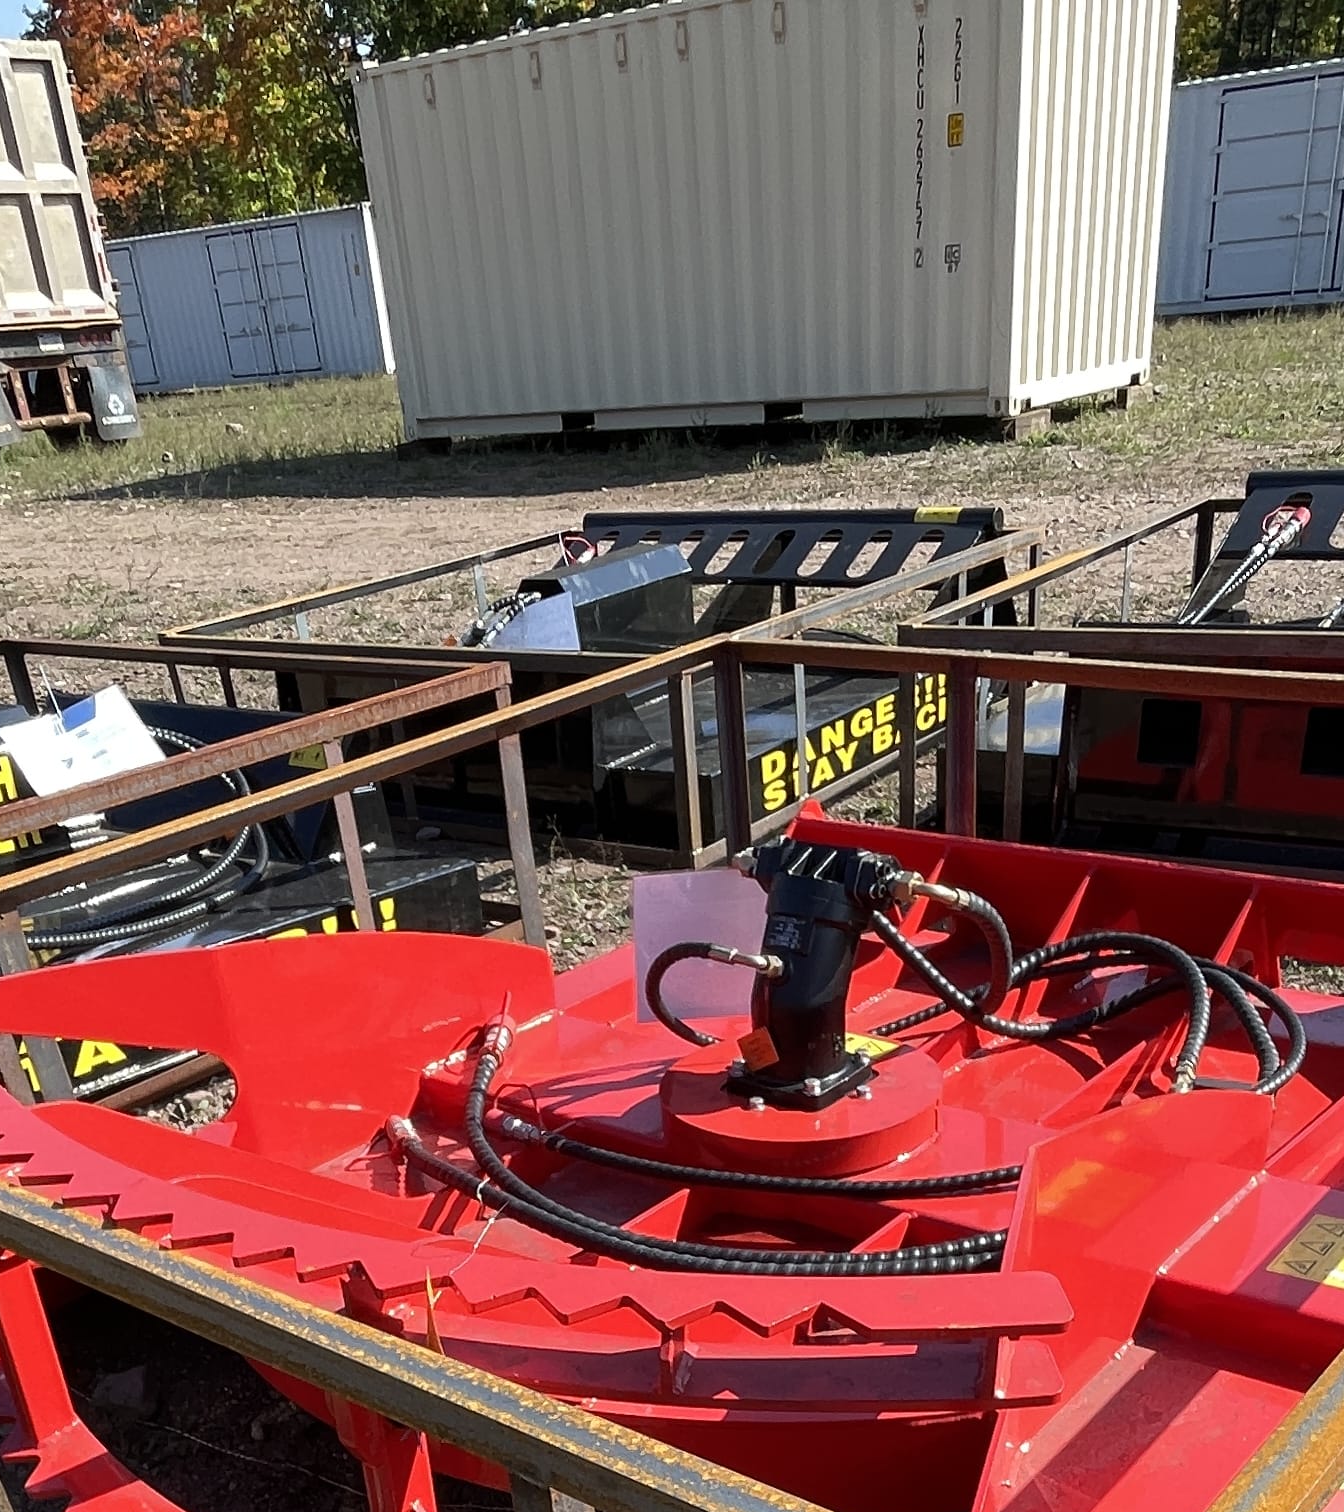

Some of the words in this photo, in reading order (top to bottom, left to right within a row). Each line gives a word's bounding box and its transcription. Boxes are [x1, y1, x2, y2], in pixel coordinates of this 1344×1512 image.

[916, 24, 925, 110] XHCU
[915, 118, 924, 240] 262757
[914, 247, 924, 268] 2
[760, 673, 947, 784] DANGE!!
